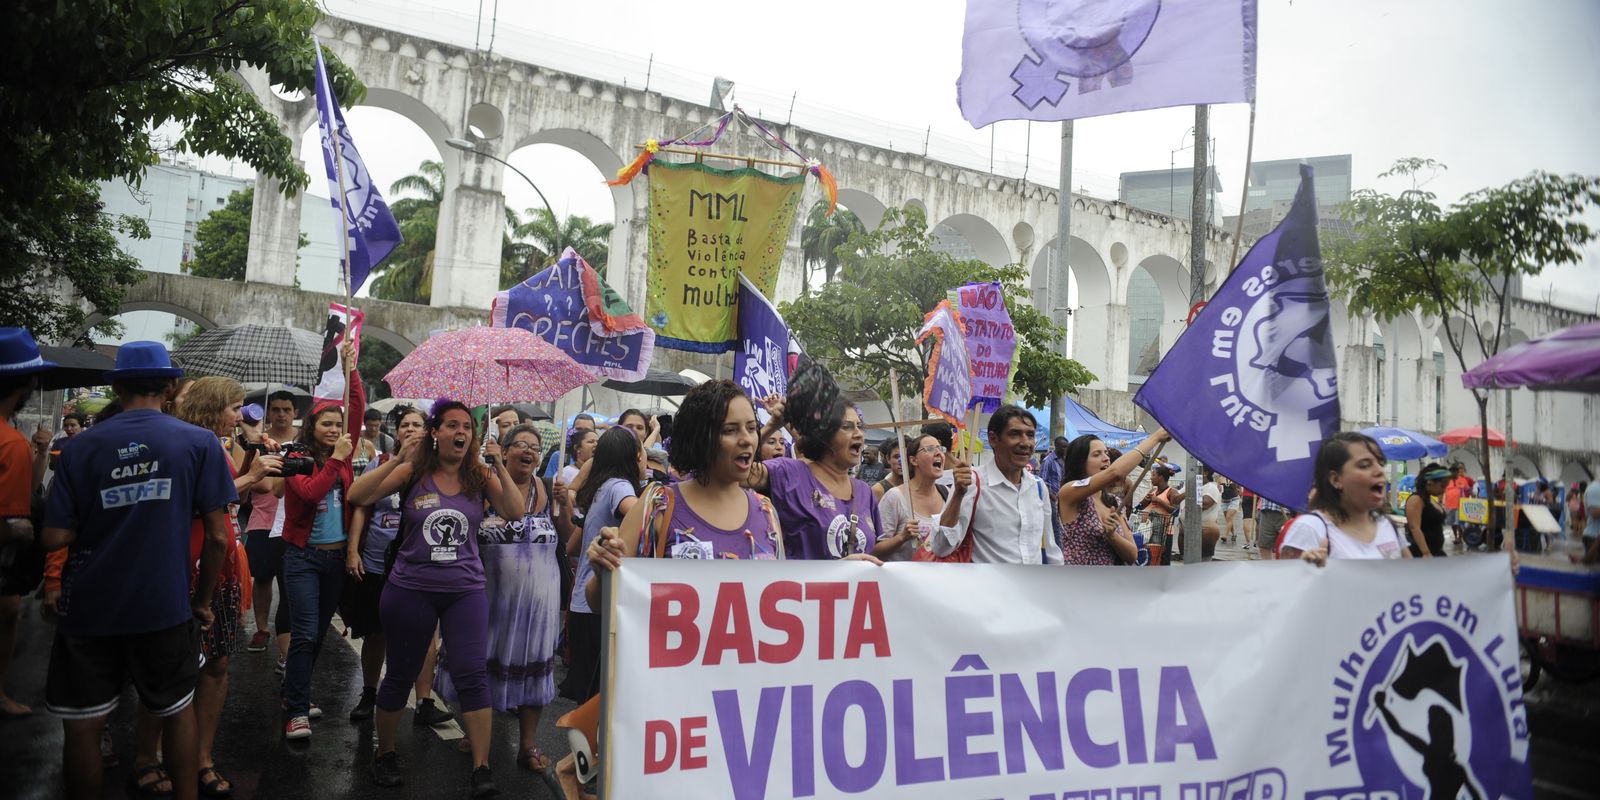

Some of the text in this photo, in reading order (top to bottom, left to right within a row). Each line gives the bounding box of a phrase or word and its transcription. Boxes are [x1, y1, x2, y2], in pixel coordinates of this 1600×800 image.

[689, 189, 748, 222] MML
[687, 228, 731, 248] Basta
[960, 285, 997, 311] NÃO
[976, 343, 992, 358] DO
[603, 360, 623, 369] MML
[111, 460, 159, 480] CAIXA
[104, 481, 169, 505] STAFF
[424, 510, 449, 531] Mulheres
[648, 580, 892, 669] BASTA
[1326, 594, 1529, 768] Mulheres em Luta
[643, 654, 1218, 800] DE VIOLÊNCIA
